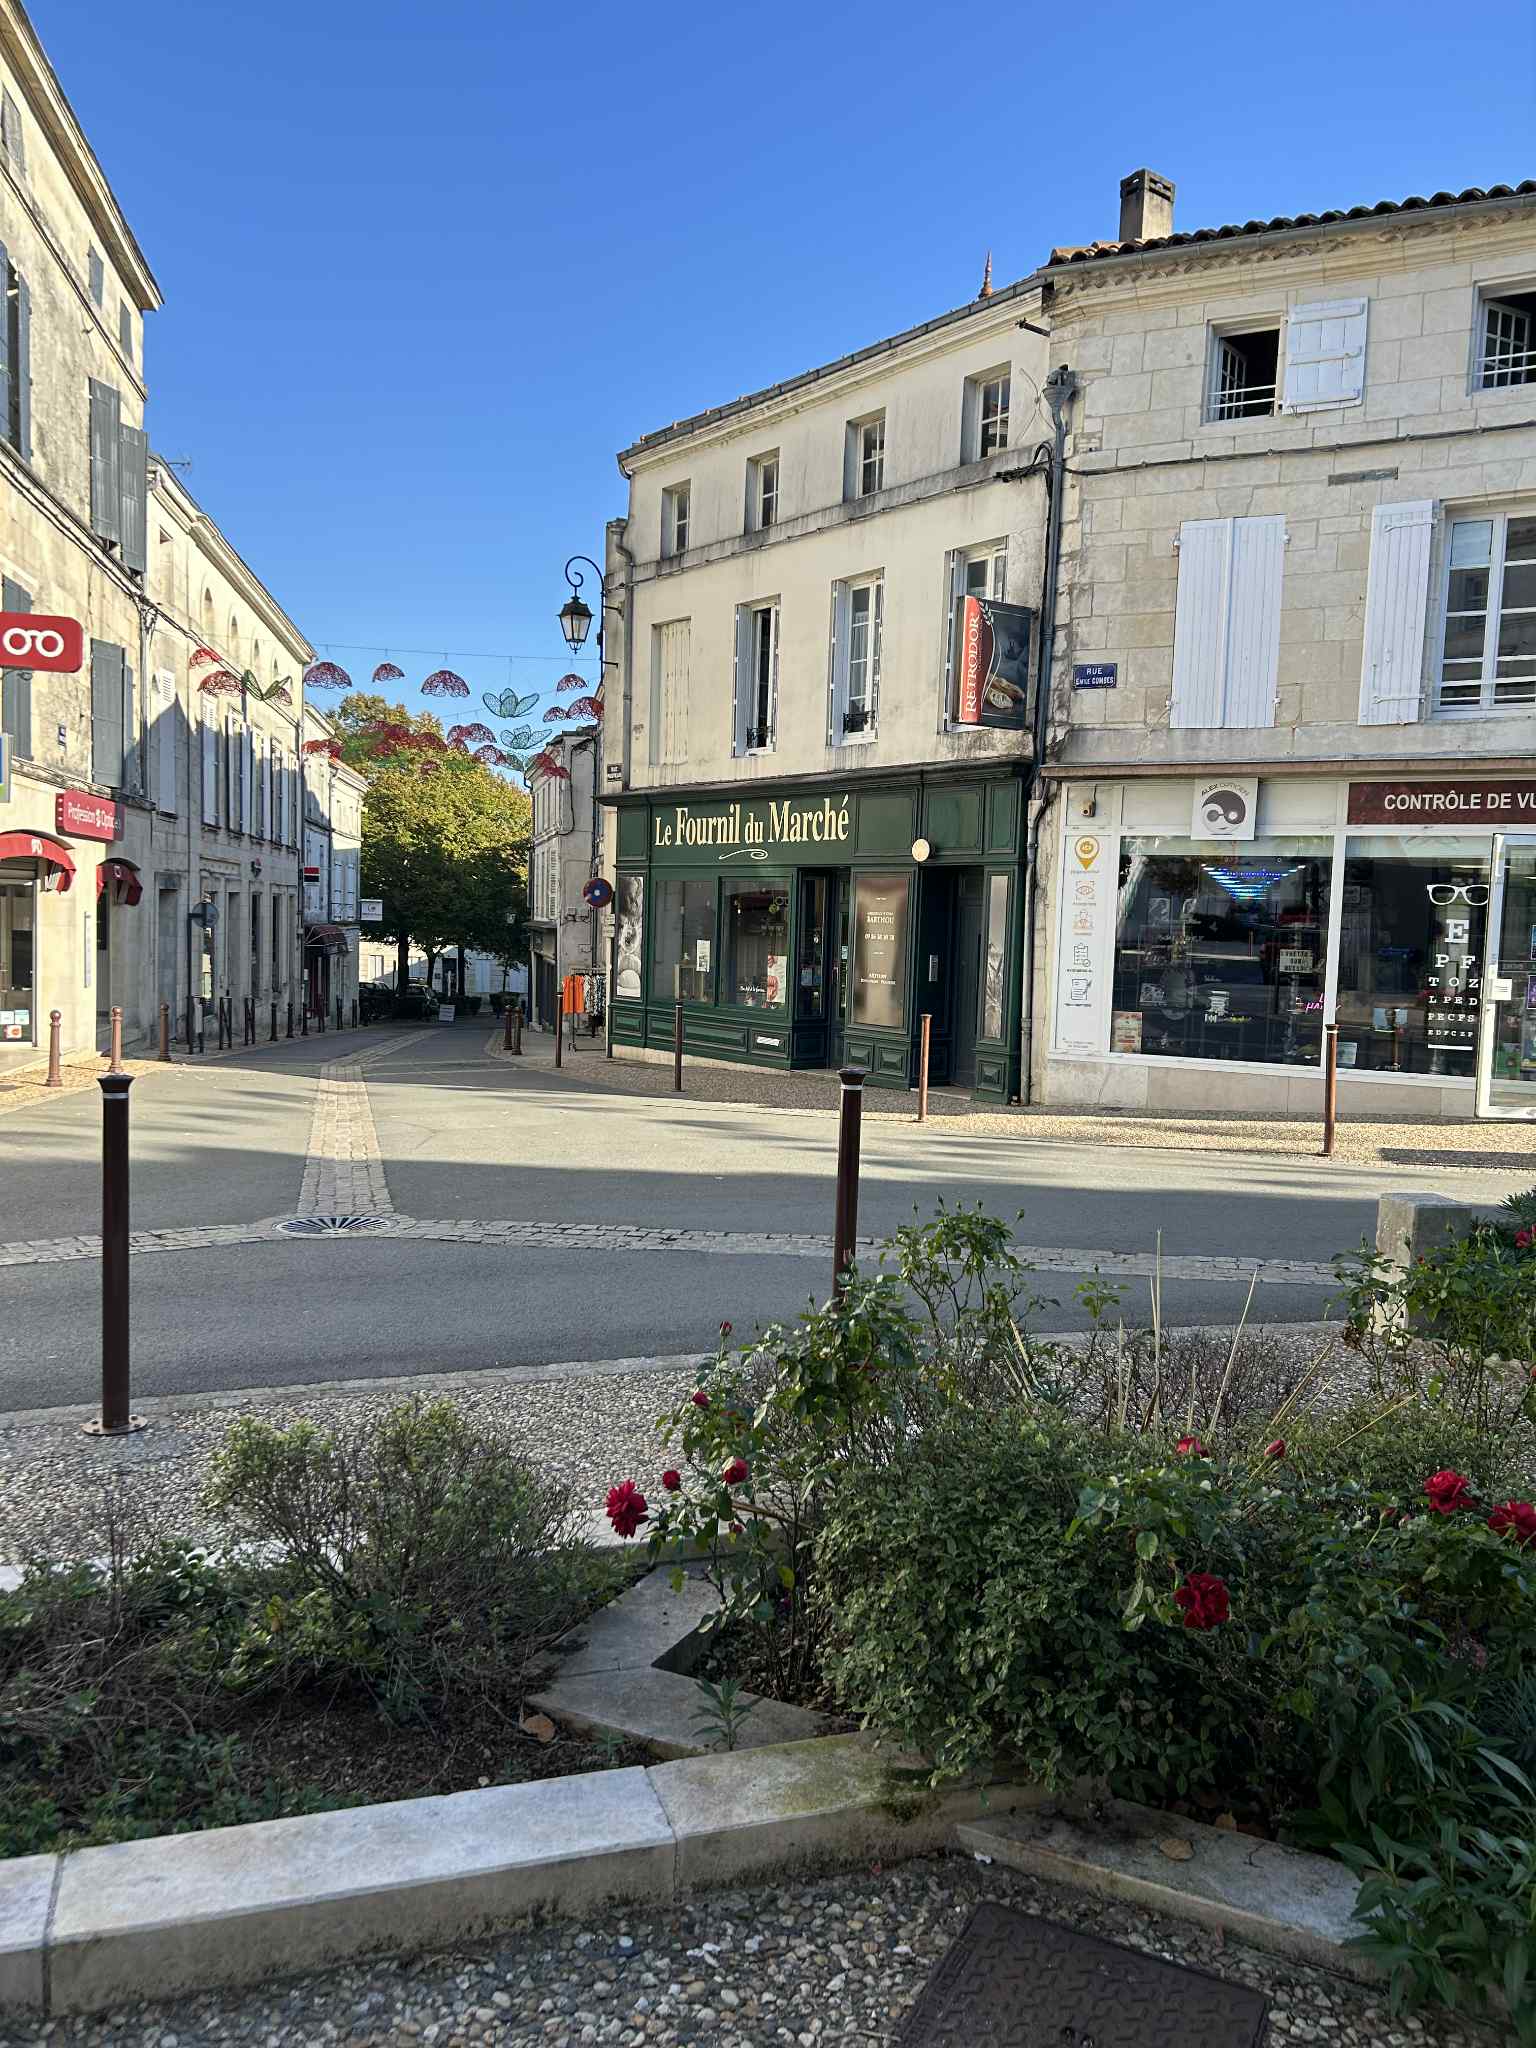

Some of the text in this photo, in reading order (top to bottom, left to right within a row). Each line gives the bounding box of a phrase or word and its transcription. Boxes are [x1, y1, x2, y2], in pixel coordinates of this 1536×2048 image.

[1086, 667, 1103, 676] RUE
[1384, 790, 1481, 810] CONTRÔLE
[1486, 792, 1512, 809] DE
[655, 794, 849, 846] Le Fournil du Marché
[1445, 919, 1470, 944] E
